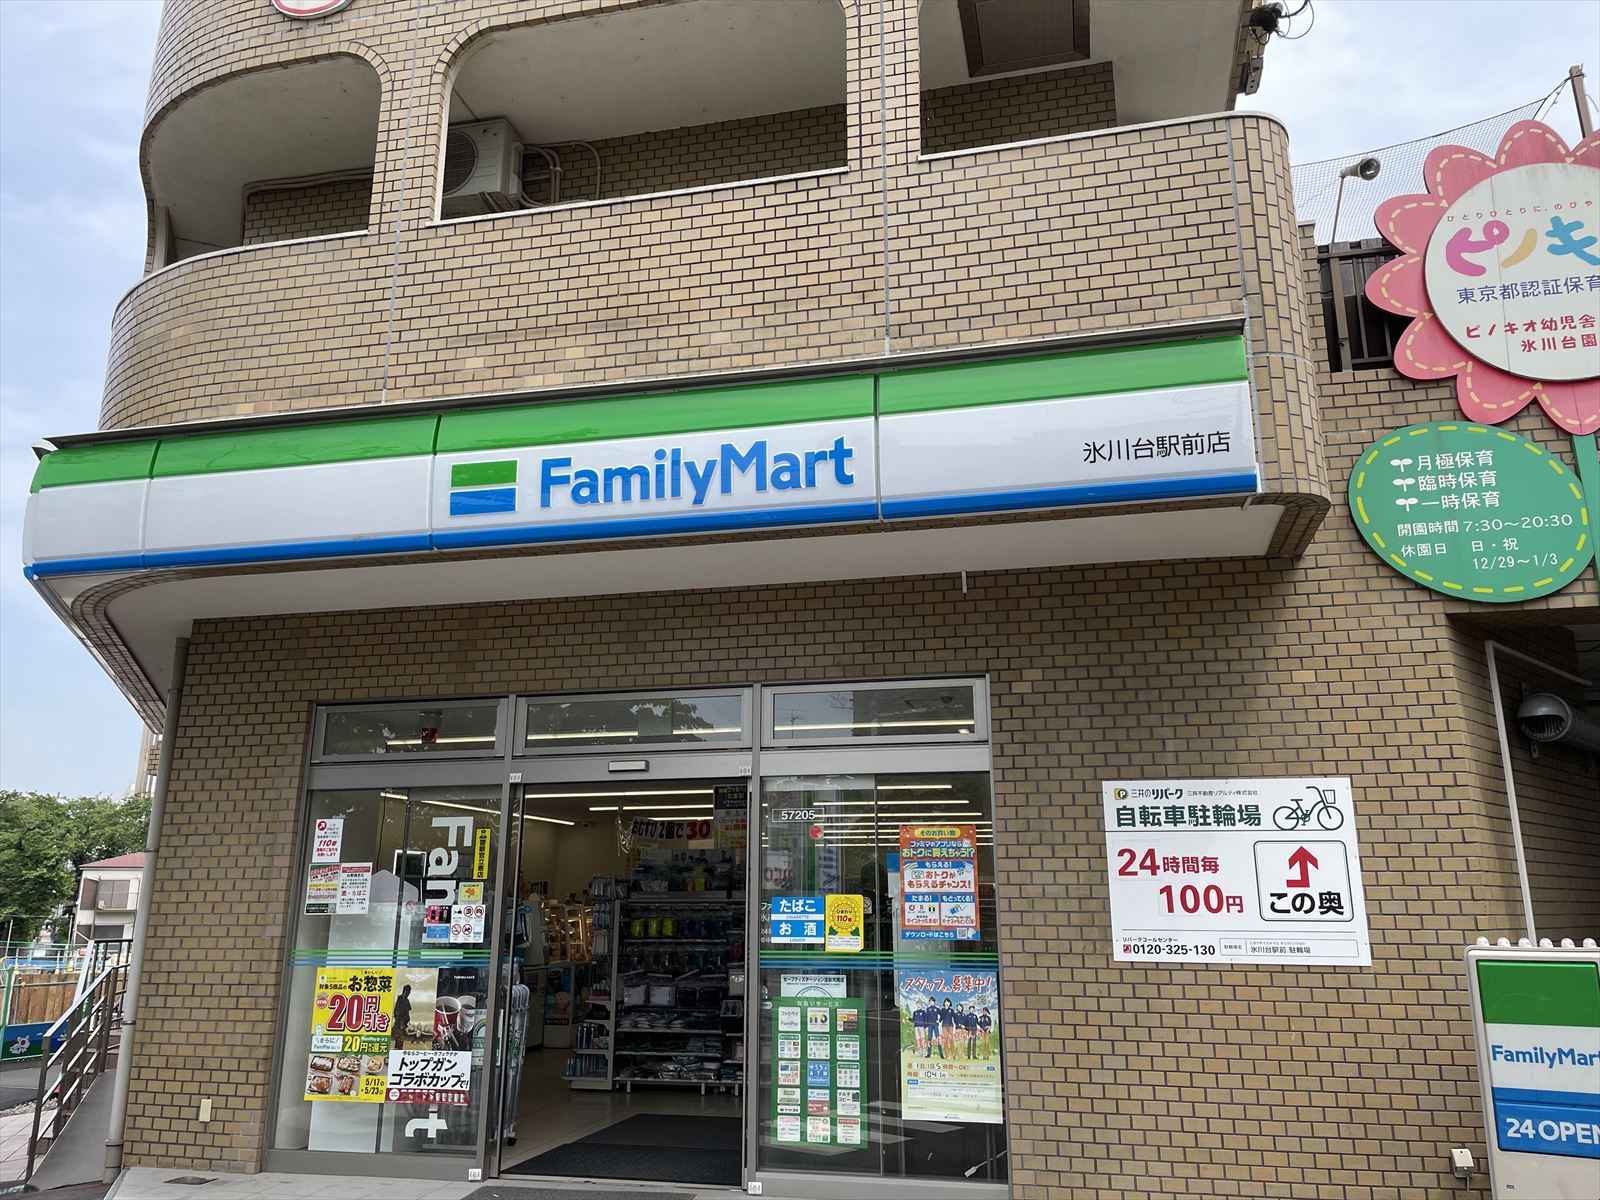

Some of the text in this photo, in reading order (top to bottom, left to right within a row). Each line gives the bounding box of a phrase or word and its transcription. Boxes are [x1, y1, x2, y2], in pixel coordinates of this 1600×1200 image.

[1457, 274, 1600, 304] 東京都認証保育
[1466, 314, 1596, 339] ピノキオ幼児舎
[1521, 333, 1598, 352] 氷川台園
[1083, 431, 1231, 464] 氷川台駅前店
[1417, 450, 1494, 471] 月極保育
[539, 434, 855, 509] FamilyMart
[1418, 470, 1497, 492] 臨時保育
[1422, 491, 1501, 511] 一時保育
[1397, 520, 1459, 537] 開園時間
[1401, 543, 1447, 557] 休園日
[1131, 788, 1183, 800] 三井のリパーク
[781, 810, 816, 820] 57205
[1116, 804, 1261, 828] 自転車駐輪場
[1117, 848, 1220, 877] 24時間毎
[925, 871, 956, 879] おトクが
[907, 880, 971, 889] もらえるチャンス!
[780, 898, 816, 913] たばこ
[1159, 883, 1244, 914] 100円
[1269, 891, 1345, 916] この奥
[1132, 943, 1216, 956] 0120-325-130
[1250, 945, 1287, 954] 氷川台駅前
[1289, 946, 1311, 954] 駐輪場
[348, 975, 393, 993] お惣菜
[399, 1057, 458, 1072] トップガン
[389, 1072, 470, 1089] コラボカップで!
